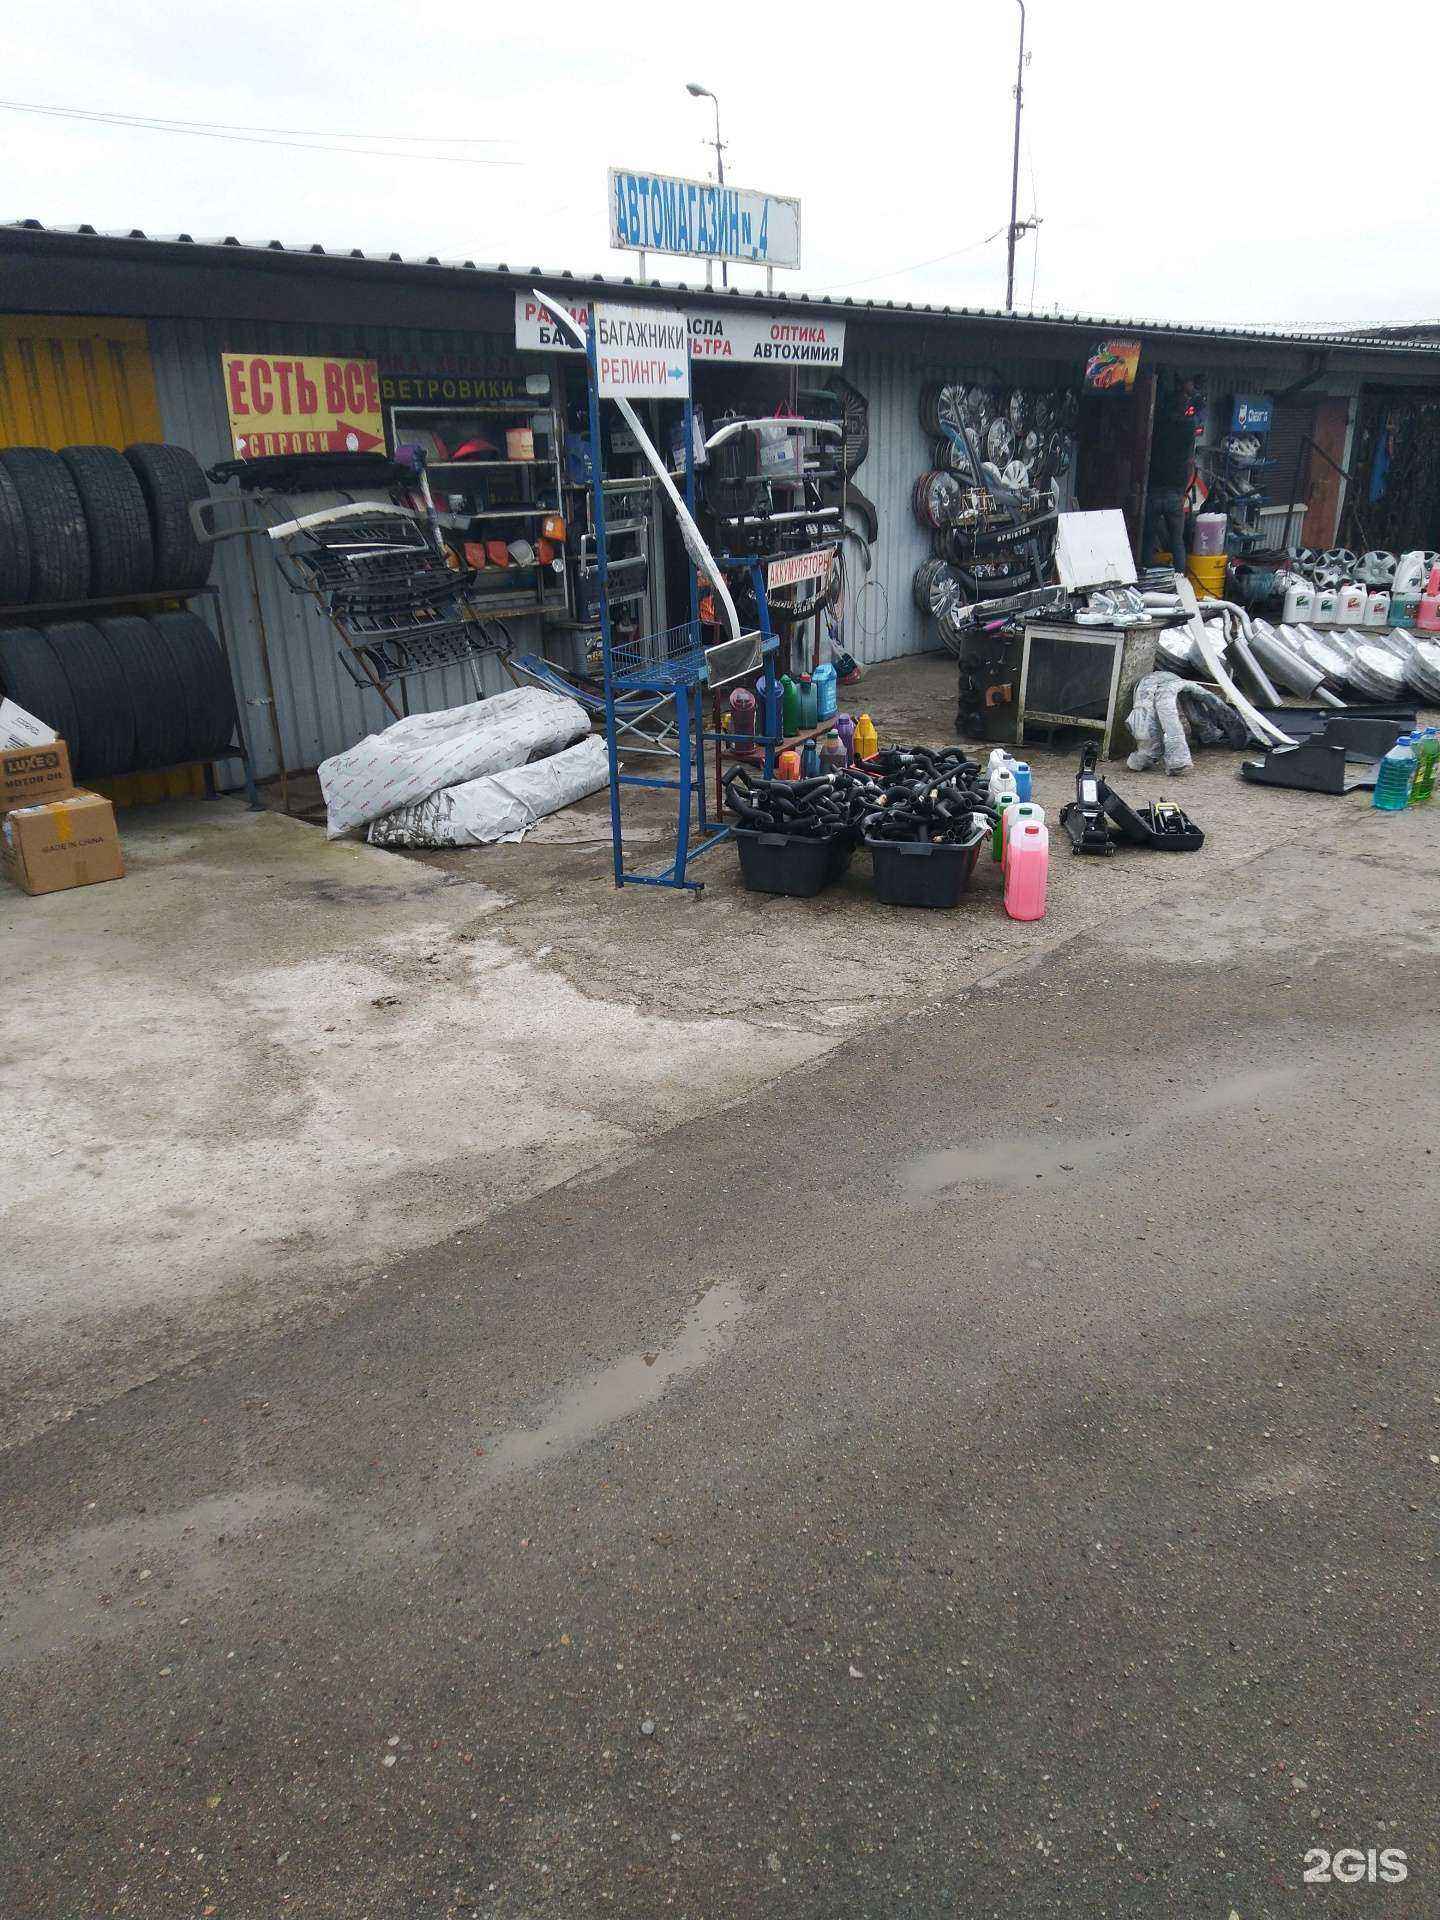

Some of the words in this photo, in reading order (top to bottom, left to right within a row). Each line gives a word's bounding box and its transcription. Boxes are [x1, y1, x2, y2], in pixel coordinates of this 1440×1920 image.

[615, 175, 739, 257] АВТОМАГАЗИН
[599, 319, 684, 349] БАГАЖНИКИ
[770, 323, 826, 342] ОПТИКА
[754, 342, 839, 362] АВТОХИМИЯ
[601, 357, 667, 384] РЕЛИНГИ
[229, 358, 318, 415] ЕСТЬ
[324, 361, 381, 414] ВСЕ
[382, 379, 514, 400] ВЕТРОВИКИ
[250, 432, 330, 457] СПРОСИ
